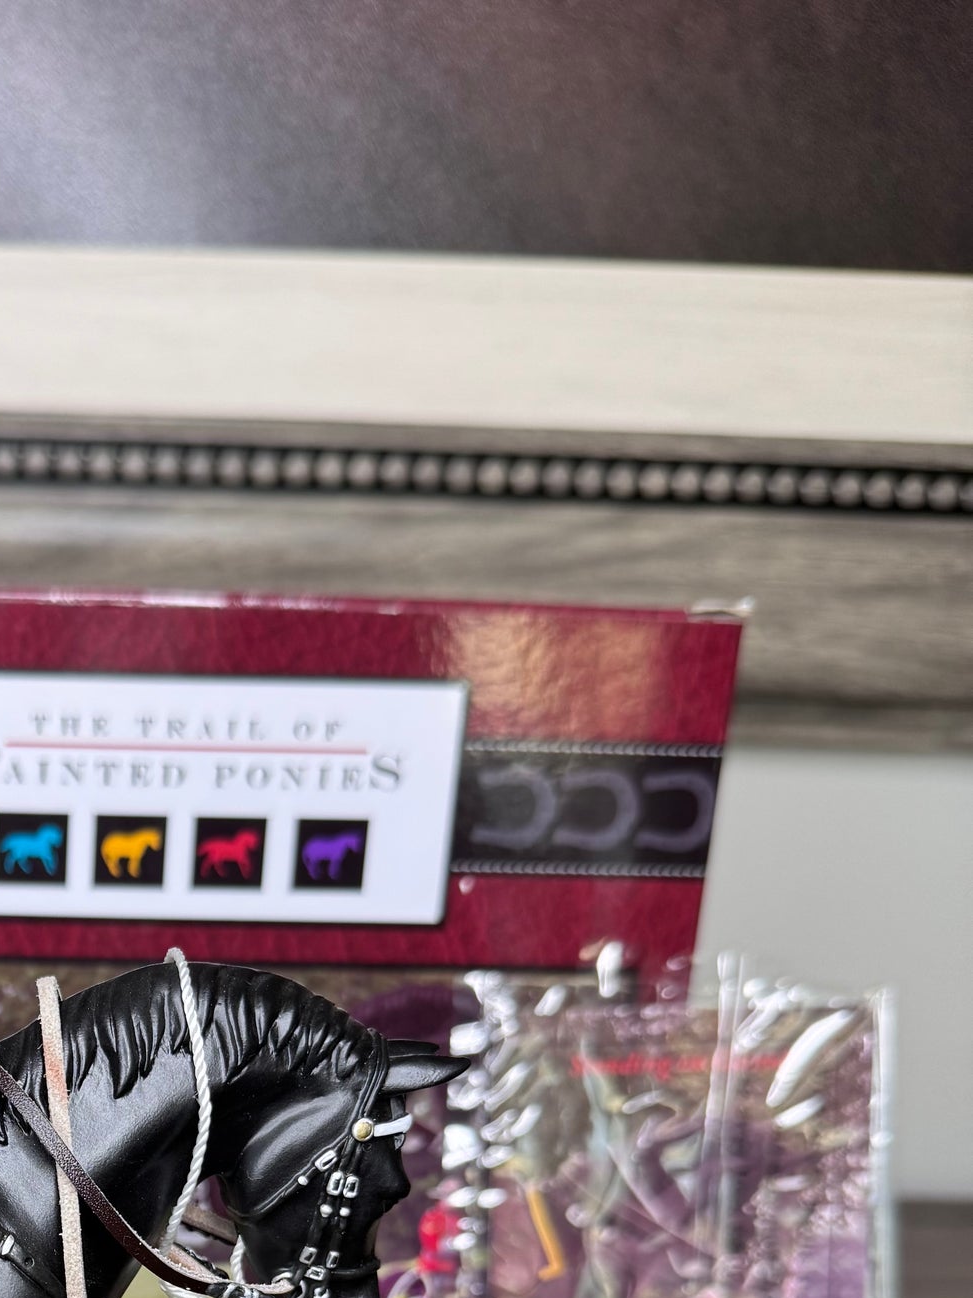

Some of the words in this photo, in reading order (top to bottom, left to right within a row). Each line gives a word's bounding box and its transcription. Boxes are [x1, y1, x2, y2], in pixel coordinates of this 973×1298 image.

[31, 712, 110, 738] THE
[134, 715, 266, 742] TRAIL
[291, 718, 343, 743] OF
[213, 752, 403, 793] PONIES
